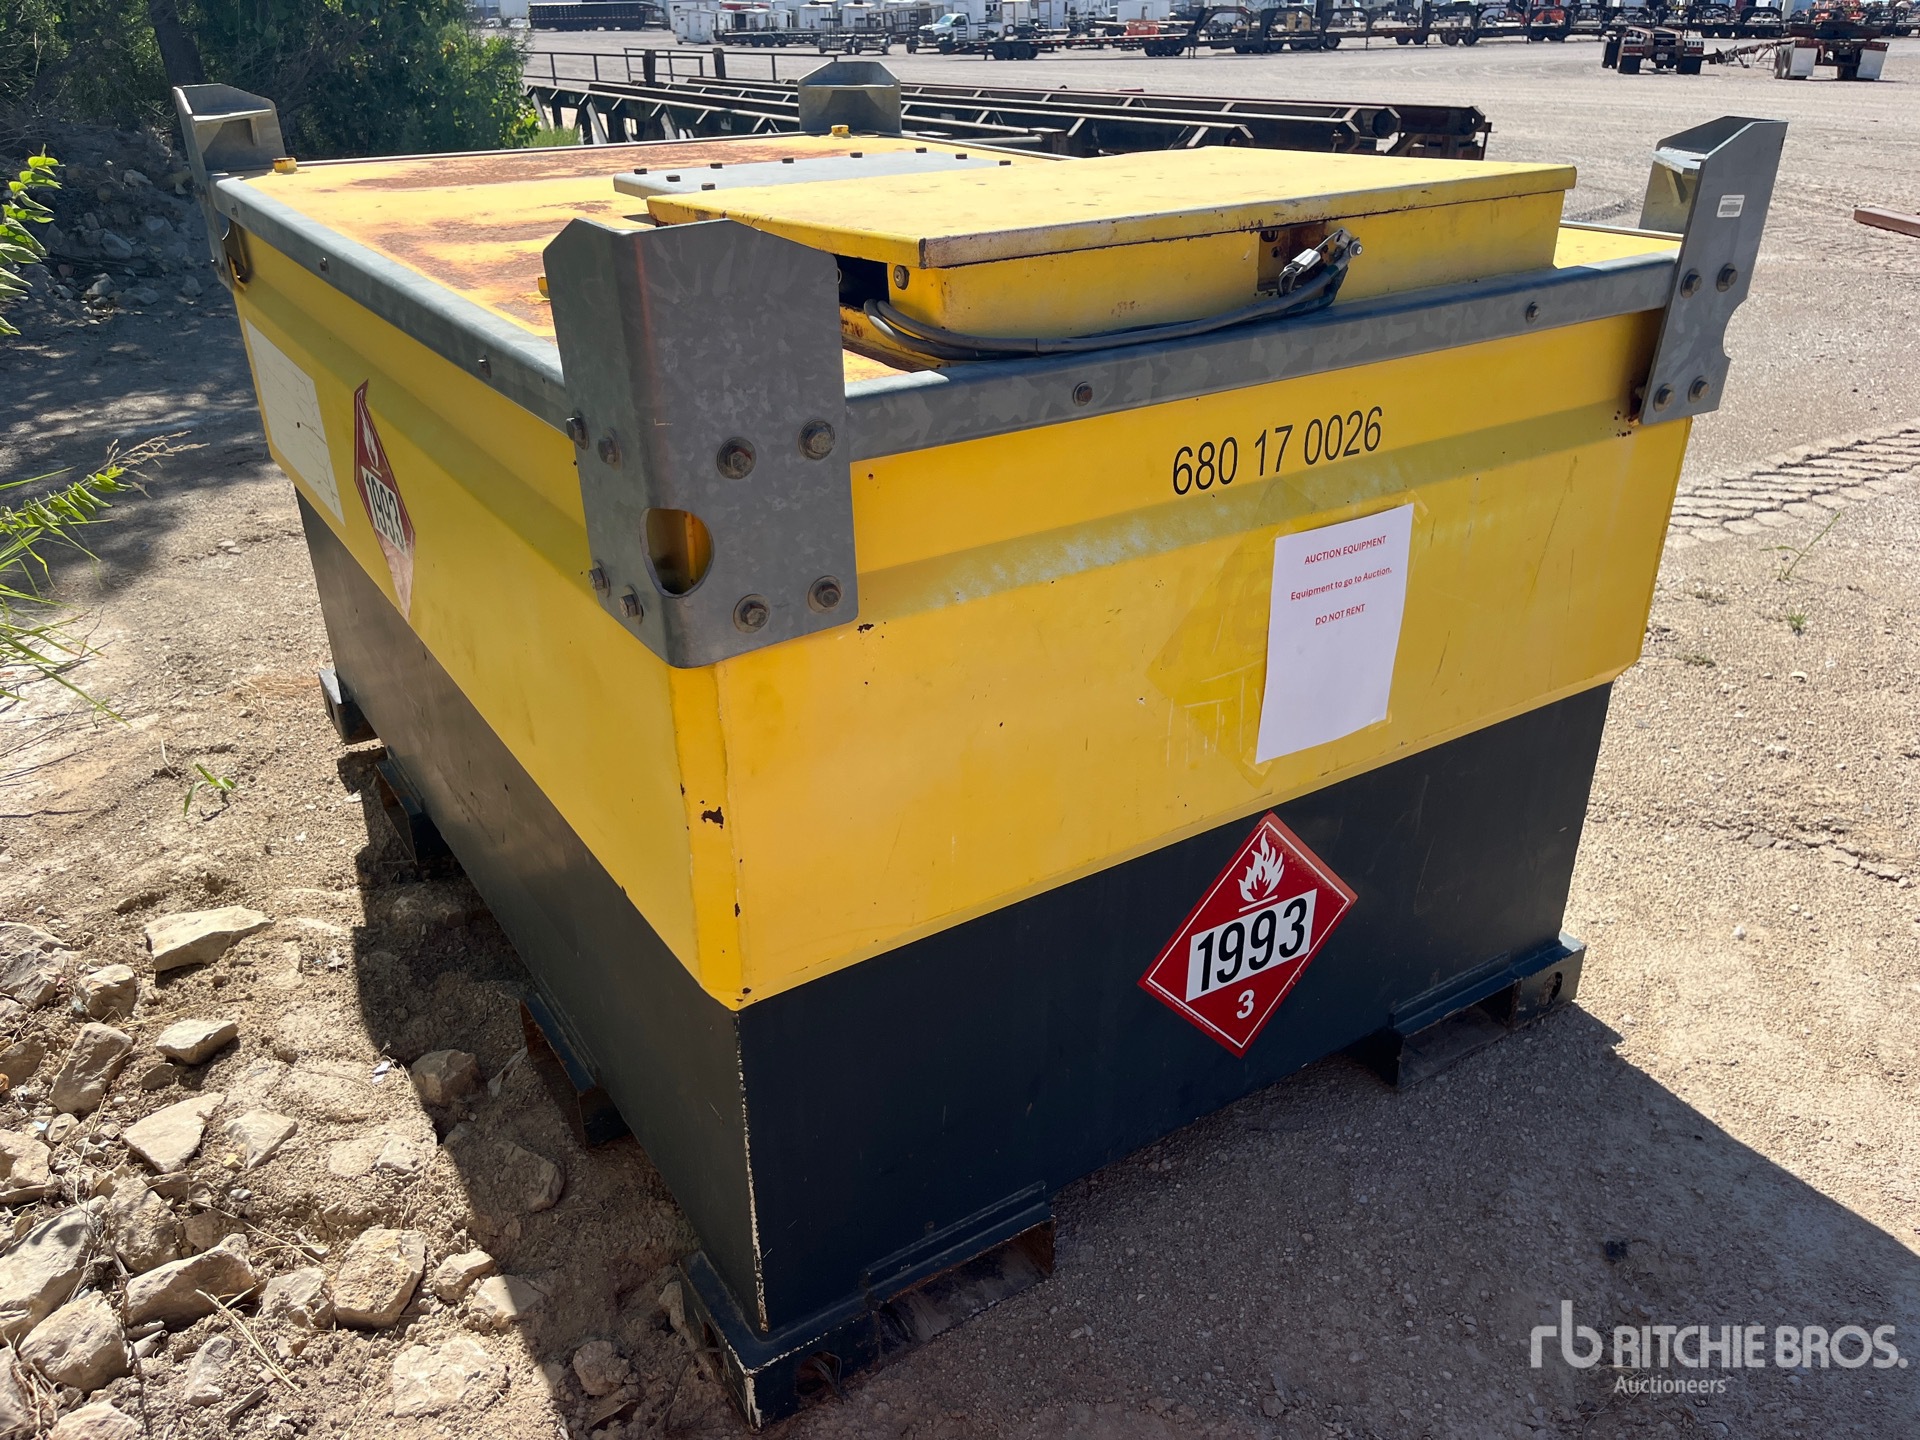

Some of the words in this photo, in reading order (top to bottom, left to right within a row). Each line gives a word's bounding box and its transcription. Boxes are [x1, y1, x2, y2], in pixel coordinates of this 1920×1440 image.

[1172, 436, 1238, 495] 680
[1254, 424, 1293, 476] 17
[1304, 406, 1383, 465] 0026
[366, 473, 405, 552] 1993
[1304, 547, 1341, 565] AUCTION
[1343, 535, 1386, 555] EQUIPMENT
[1290, 582, 1334, 601] Equipment
[1335, 580, 1342, 589] to
[1343, 578, 1353, 588] go
[1354, 575, 1362, 583] to
[1363, 567, 1392, 581] Auction.
[1315, 614, 1327, 626] DO
[1328, 609, 1345, 619] NOT
[1346, 603, 1365, 615] RENT
[1197, 897, 1307, 993] 1993
[1236, 989, 1255, 1019] 3
